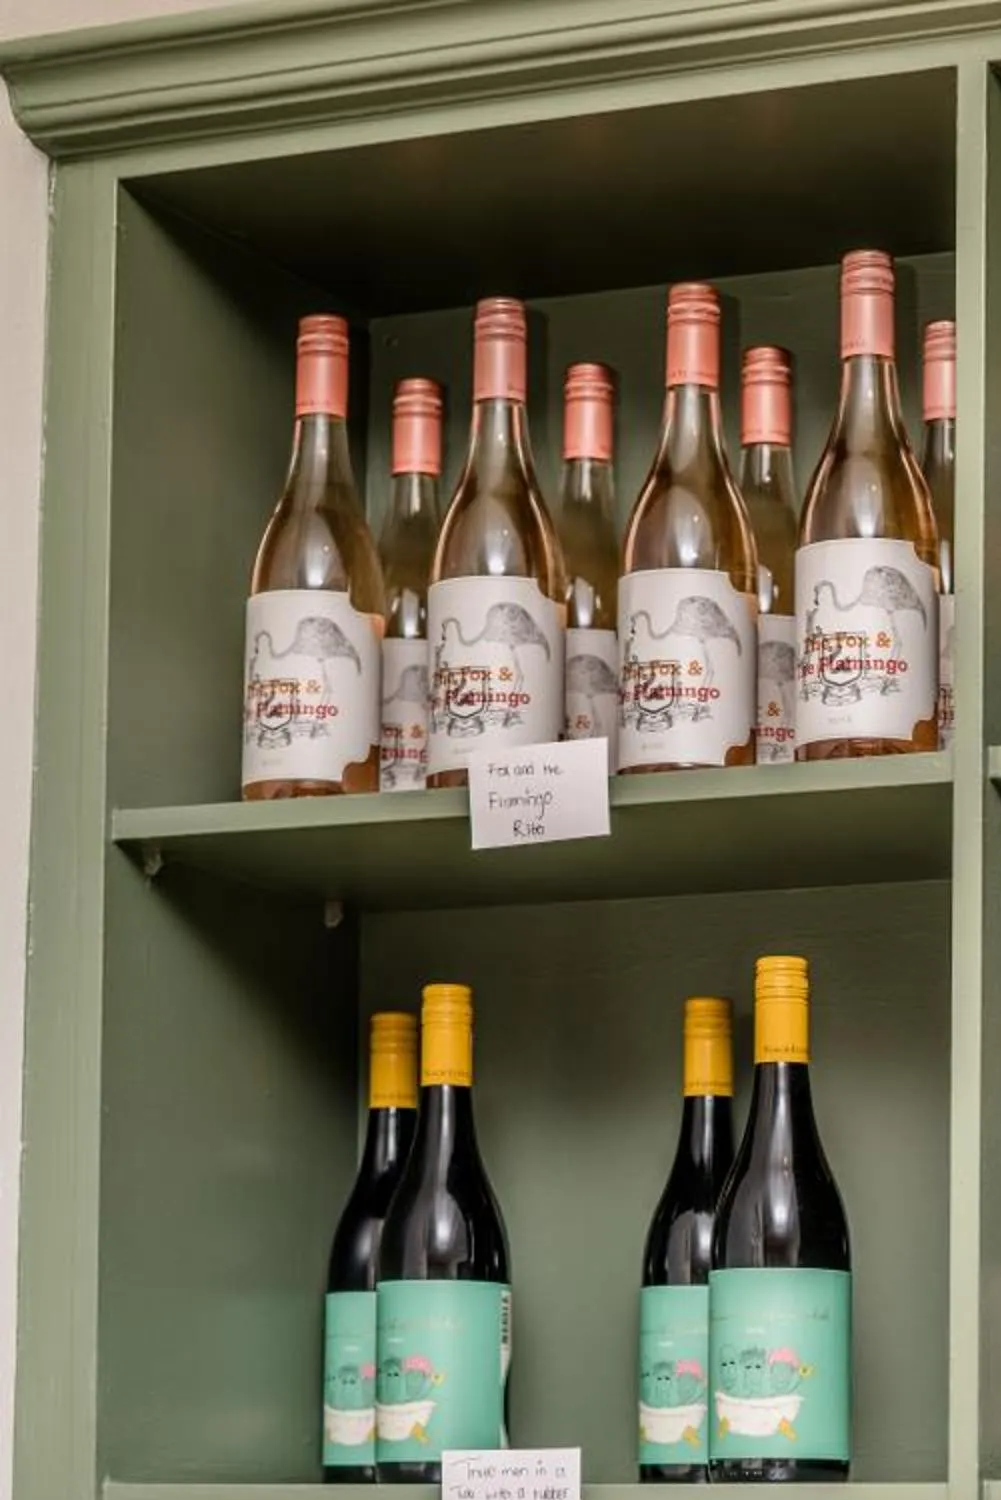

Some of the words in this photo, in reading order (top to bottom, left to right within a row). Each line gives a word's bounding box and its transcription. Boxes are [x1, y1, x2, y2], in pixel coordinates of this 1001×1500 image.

[874, 631, 891, 649] &
[687, 660, 704, 676] &
[817, 655, 909, 675] Flamingo
[498, 667, 513, 681] &
[305, 680, 322, 694] &
